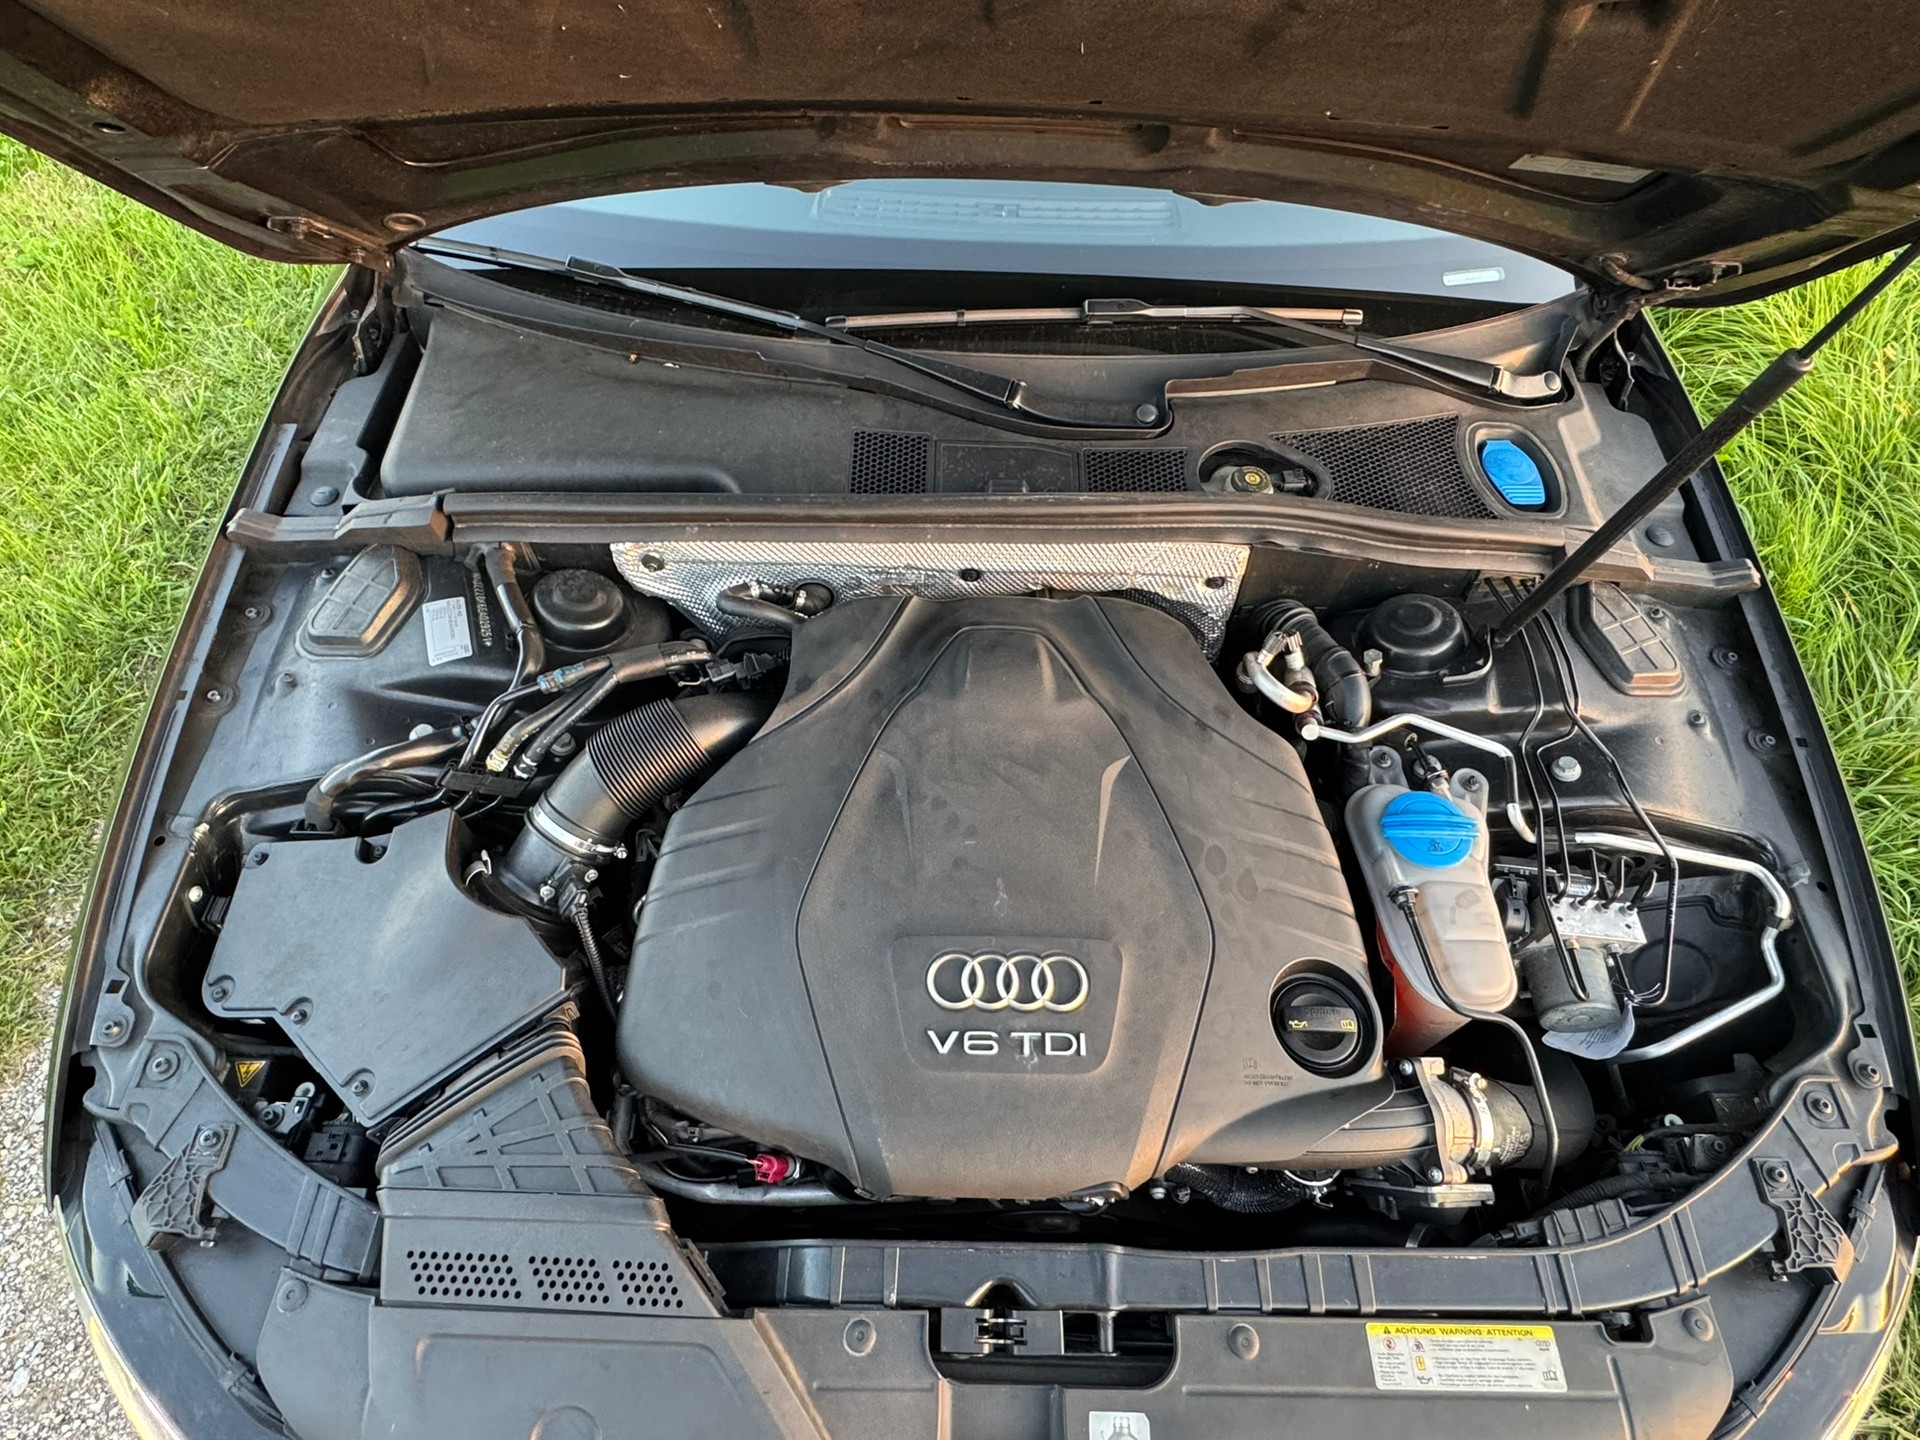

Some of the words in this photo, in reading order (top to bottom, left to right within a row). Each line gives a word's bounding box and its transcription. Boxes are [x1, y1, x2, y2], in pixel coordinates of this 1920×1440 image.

[927, 1030, 999, 1055] V6
[1010, 1032, 1087, 1057] TDI
[1394, 1326, 1436, 1335] ACHTUNG
[1439, 1327, 1482, 1336] WARNING
[1486, 1328, 1533, 1337] ATTENTION
